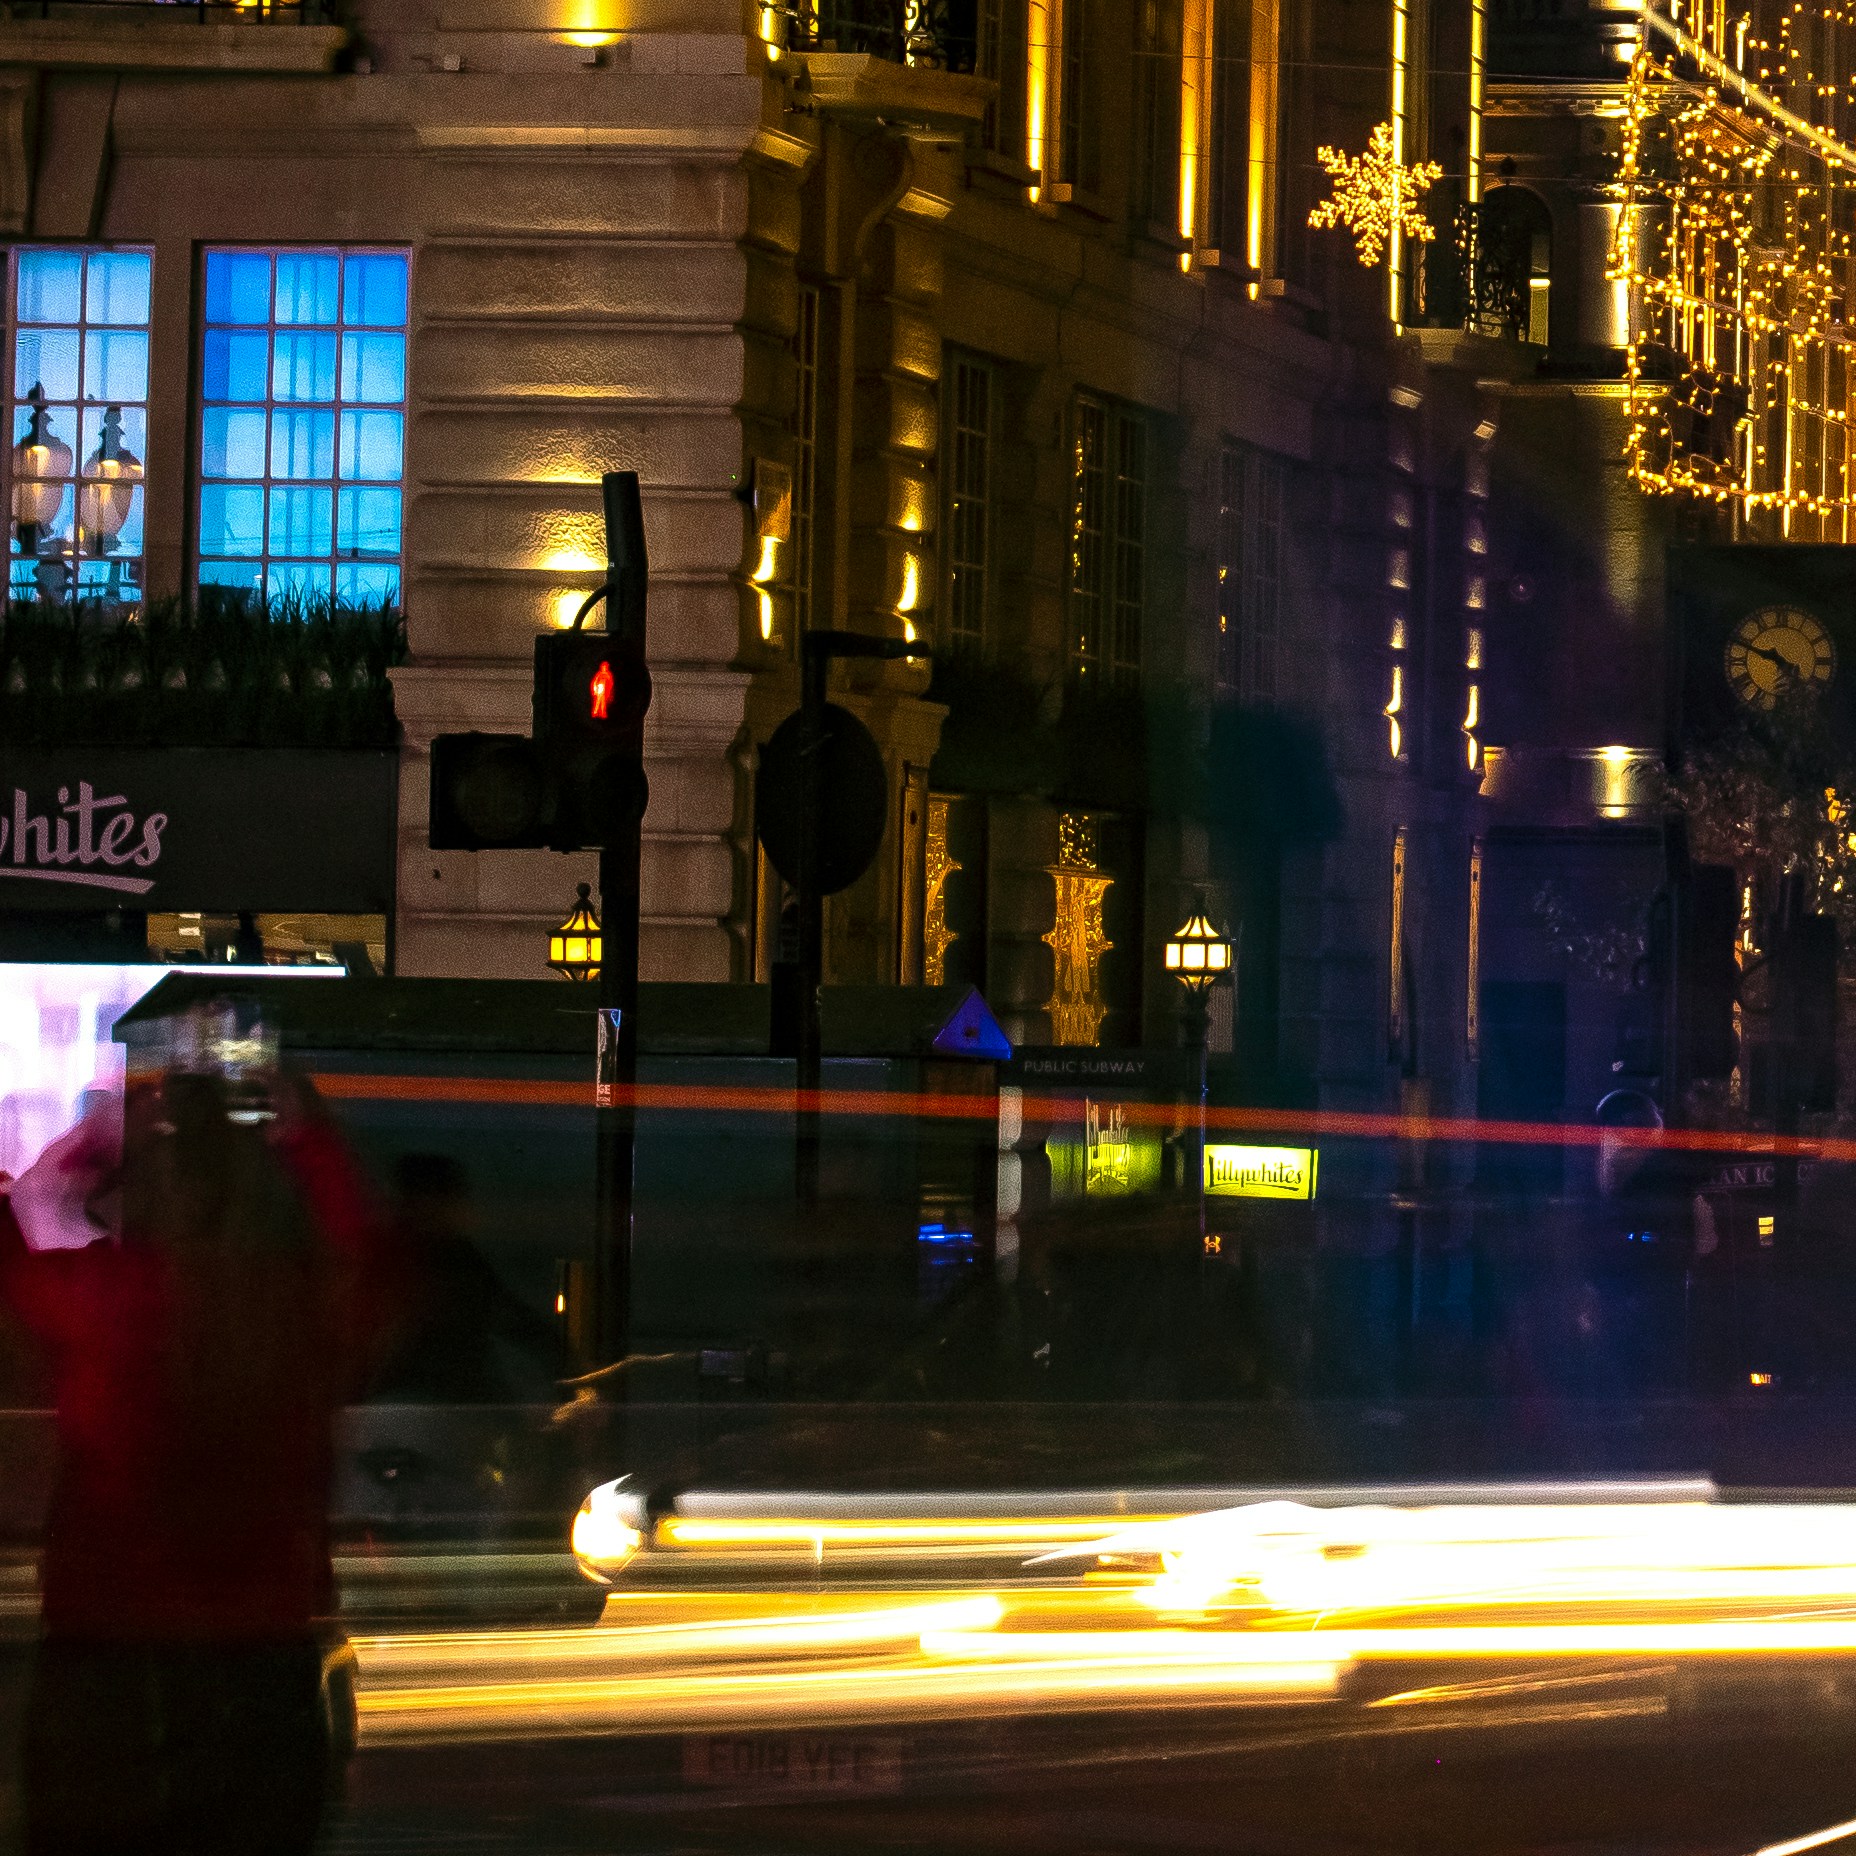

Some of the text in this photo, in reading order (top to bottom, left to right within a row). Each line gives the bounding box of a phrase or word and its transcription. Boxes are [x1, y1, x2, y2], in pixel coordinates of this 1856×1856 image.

[0, 781, 168, 866] hites
[1023, 1059, 1146, 1074] PUBLIC SUBWAY
